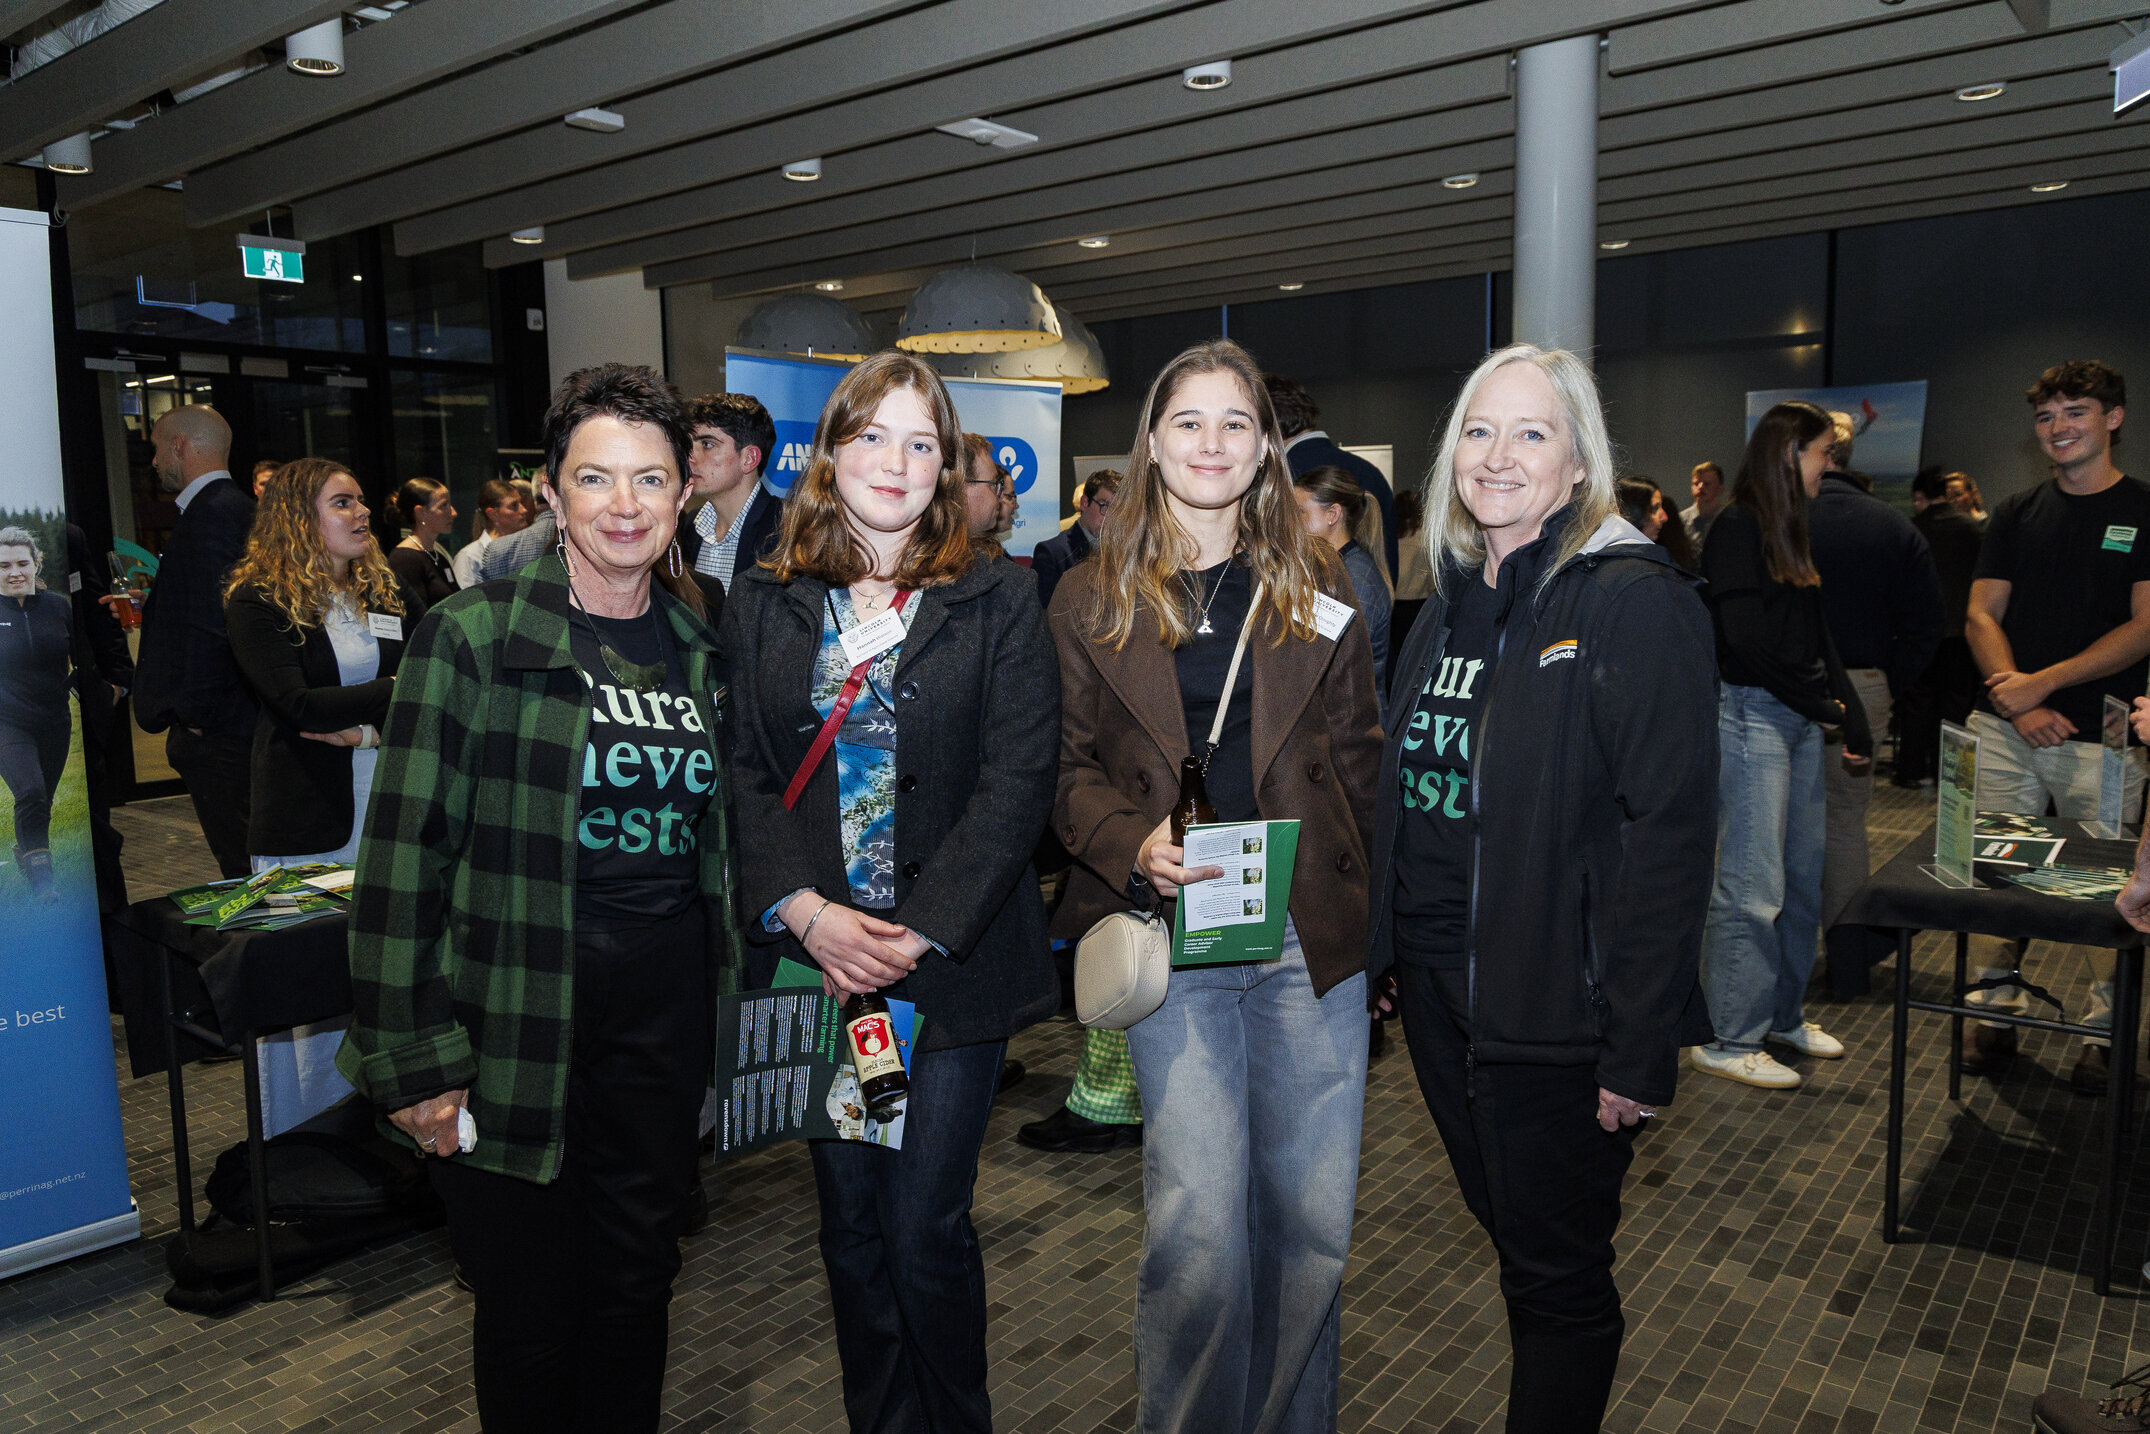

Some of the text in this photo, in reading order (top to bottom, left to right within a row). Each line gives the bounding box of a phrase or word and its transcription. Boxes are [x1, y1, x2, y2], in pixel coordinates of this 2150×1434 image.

[1540, 649, 1576, 667] Farmlands
[1422, 648, 1485, 700] ur
[579, 801, 698, 857] ests
[1185, 930, 1222, 938] EMPOWER
[16, 1005, 66, 1027] best
[817, 996, 830, 1053] smarter farming
[829, 1024, 837, 1040] that
[857, 1020, 880, 1034] MAC'S
[826, 1040, 835, 1064] power
[863, 1063, 879, 1074] APPLE
[879, 1059, 896, 1067] CIDER
